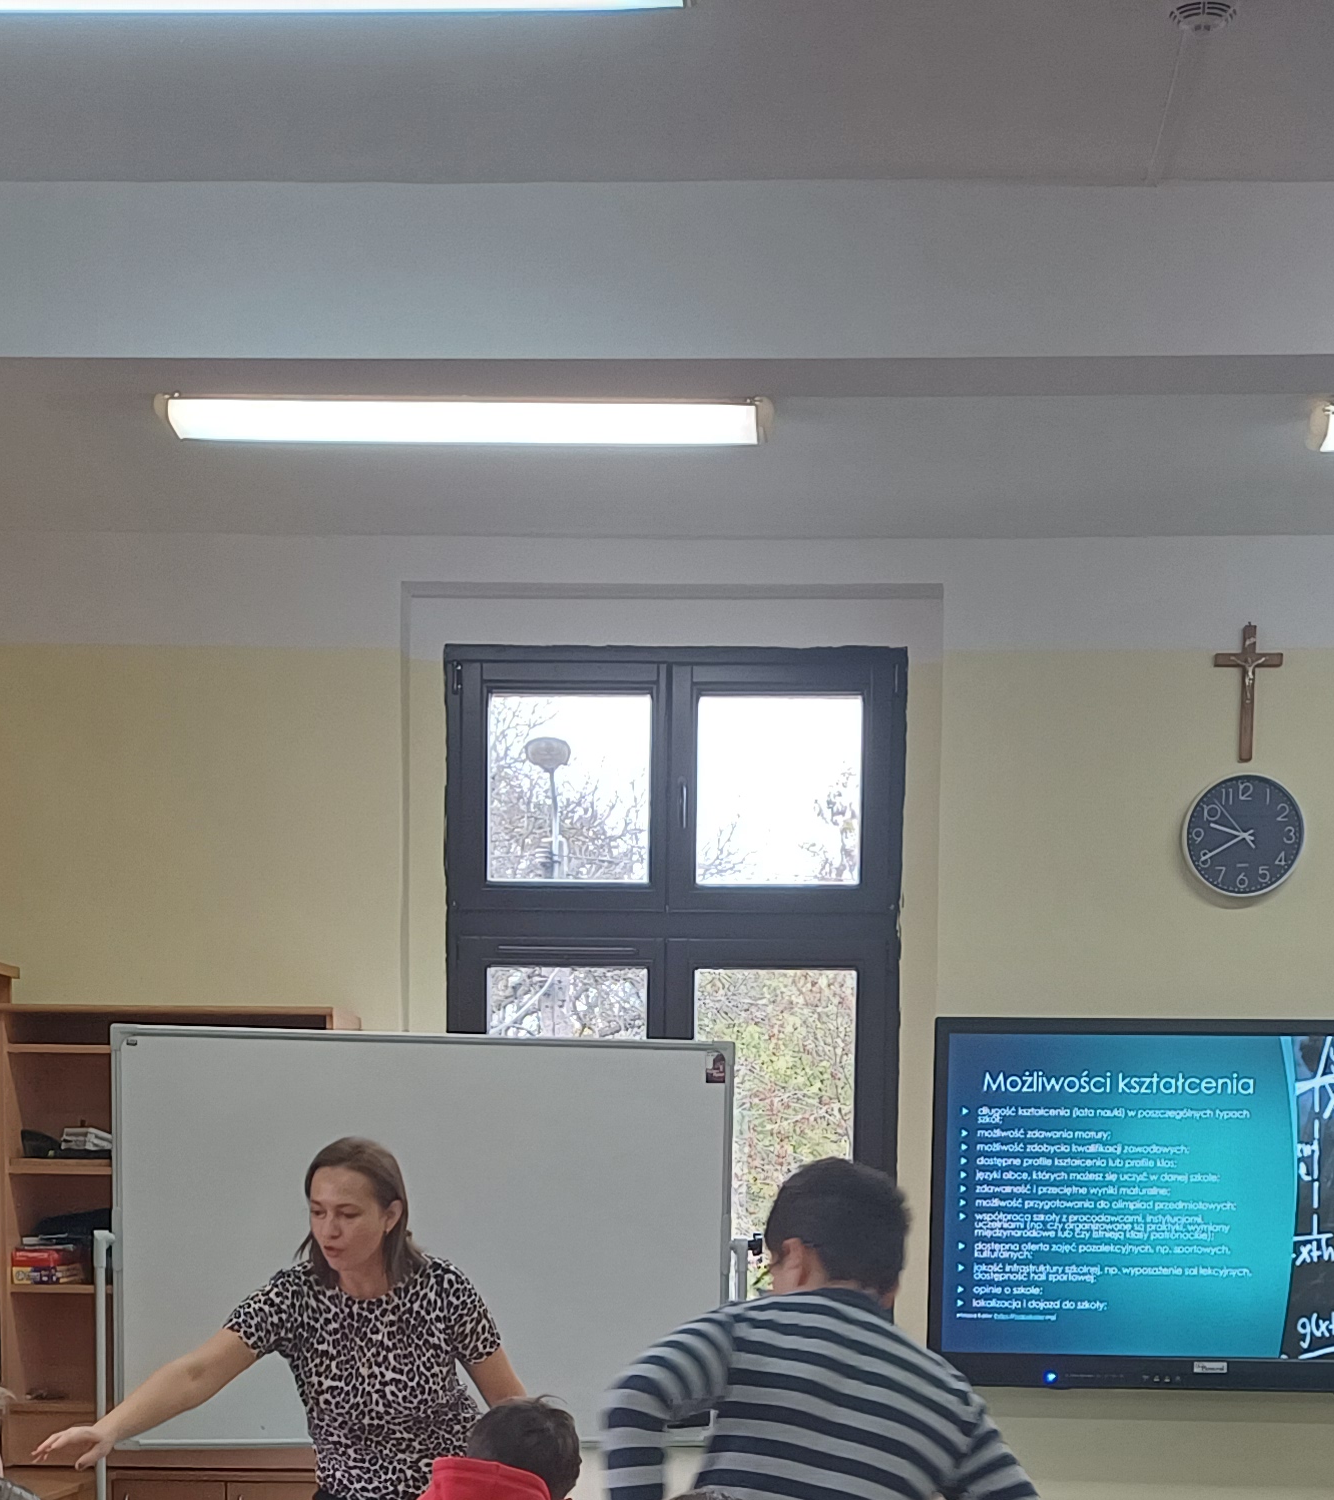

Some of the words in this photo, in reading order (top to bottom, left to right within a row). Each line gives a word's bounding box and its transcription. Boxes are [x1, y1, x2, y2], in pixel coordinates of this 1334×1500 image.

[1221, 788, 1233, 805] 11
[1238, 782, 1253, 801] 12
[1266, 788, 1271, 804] 1
[1203, 804, 1221, 821] 10
[1276, 804, 1289, 822] 2
[1192, 828, 1204, 844] 9
[1283, 827, 1296, 844] 3
[1199, 850, 1211, 868] 8
[1275, 851, 1286, 866] 4
[1215, 866, 1226, 883] 7
[1237, 873, 1248, 888] 6
[1258, 866, 1270, 882] 5
[983, 1071, 1111, 1093] Możliwości
[1118, 1073, 1254, 1094] kształcenia
